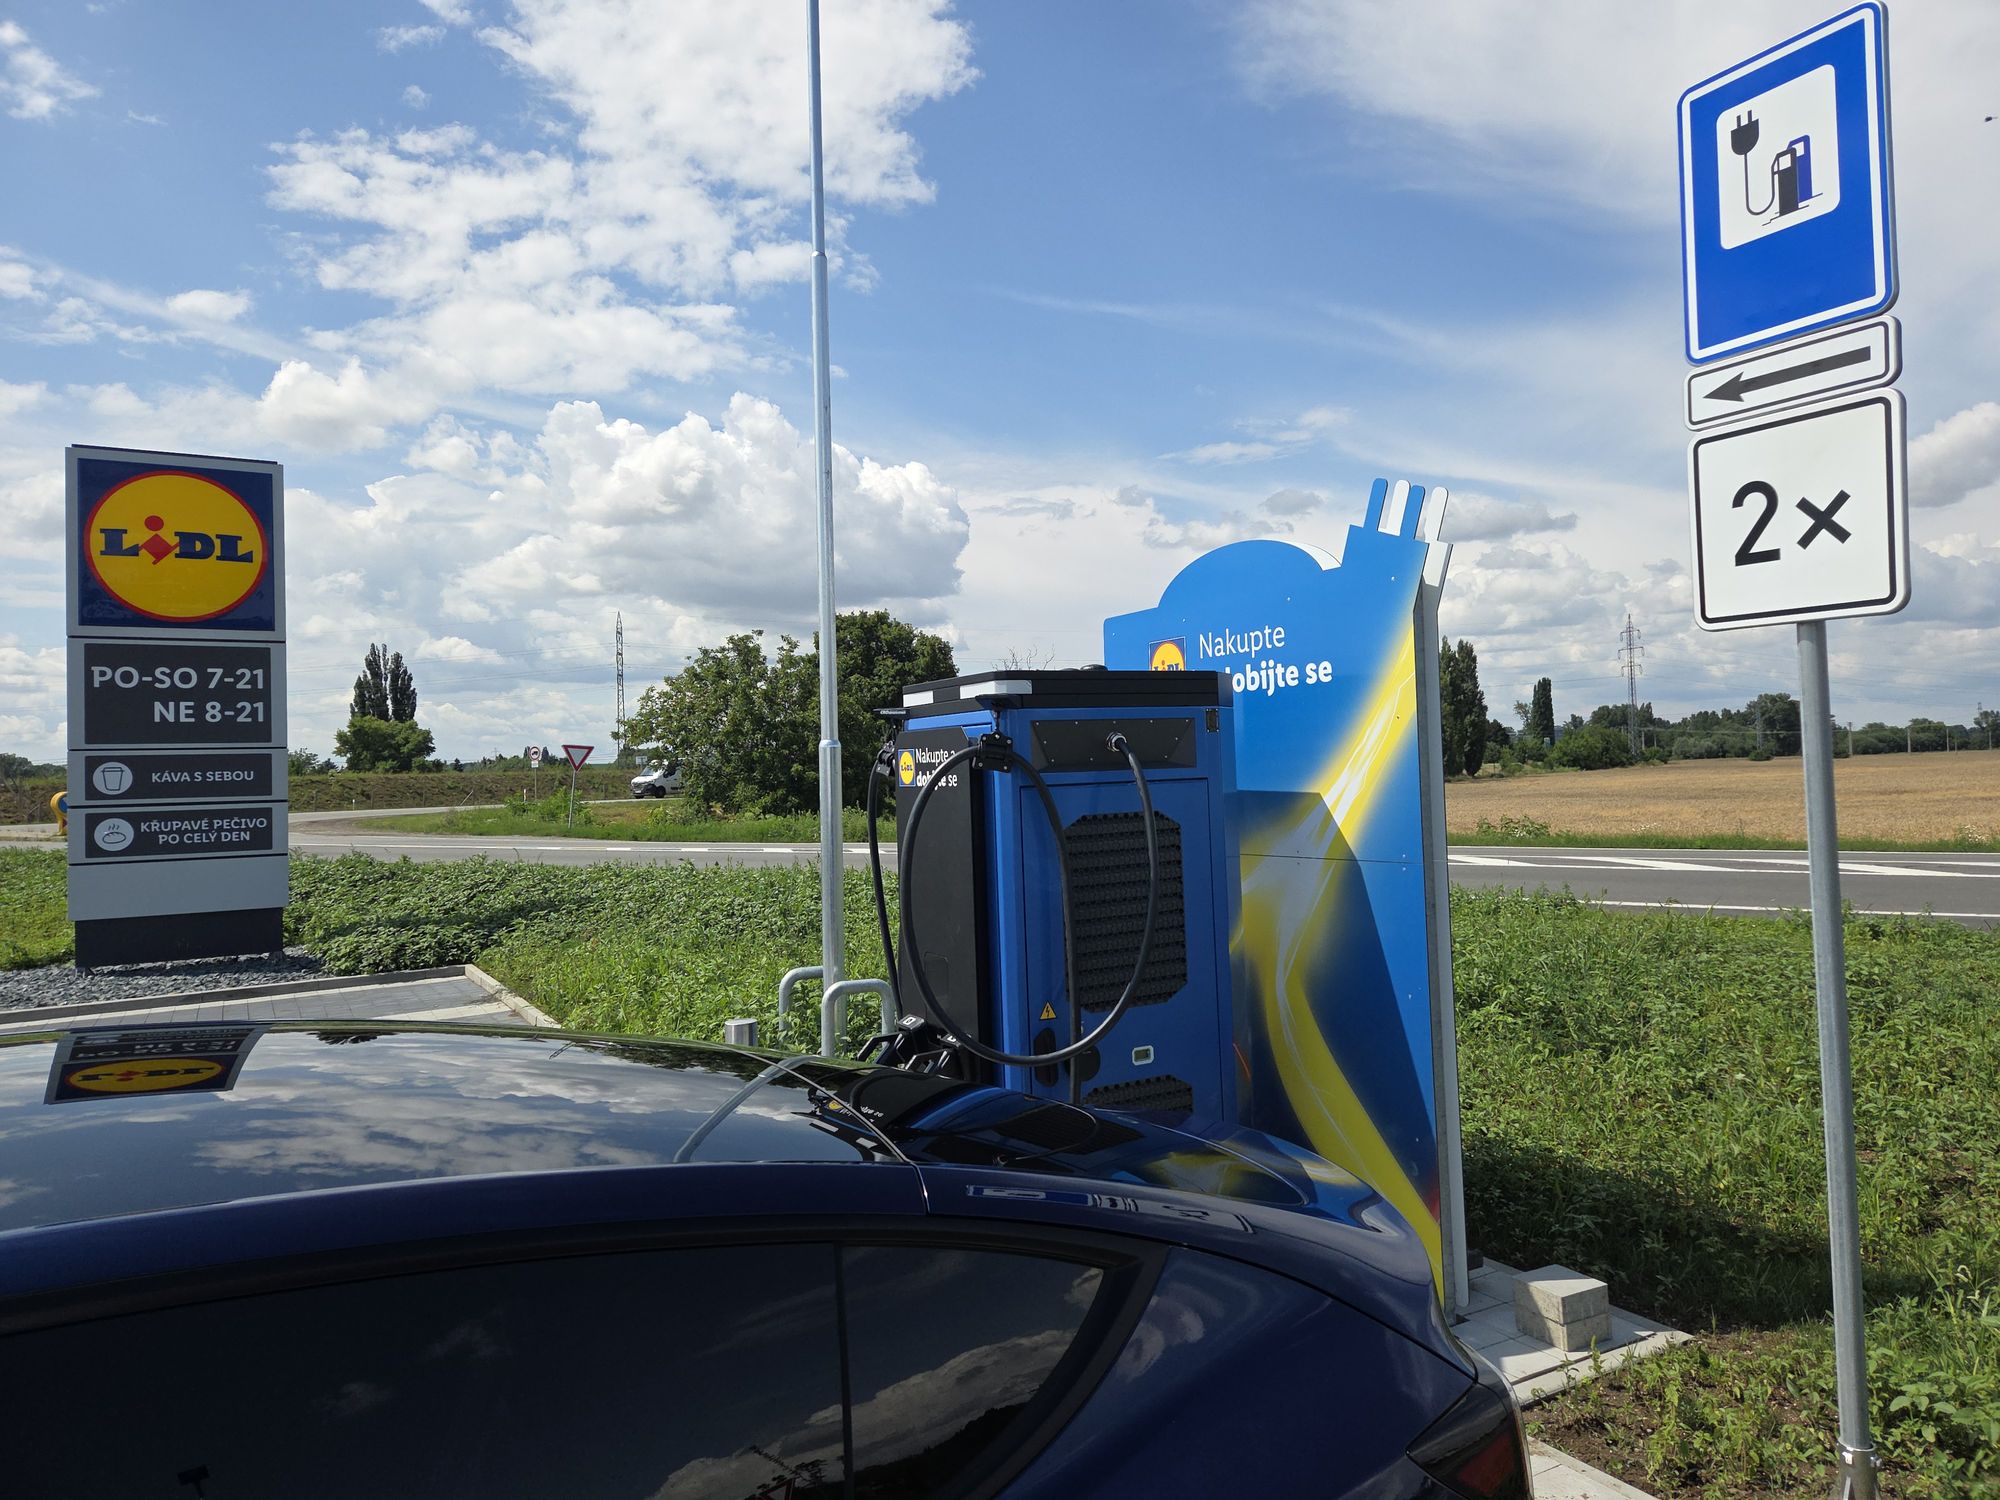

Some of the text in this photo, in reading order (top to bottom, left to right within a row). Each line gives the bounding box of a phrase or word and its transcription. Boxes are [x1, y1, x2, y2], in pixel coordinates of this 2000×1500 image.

[1200, 625, 1285, 659] Nakupte
[91, 666, 264, 689] PO-SO 7-21
[1225, 659, 1333, 696] obijte se
[153, 701, 264, 723] NE 8-21
[915, 748, 948, 766] Nakupte
[152, 771, 254, 783] KÁVA S SEBOU
[948, 774, 958, 787] se
[213, 817, 267, 829] PEČIVO
[158, 830, 250, 845] PO CELÝ DEN
